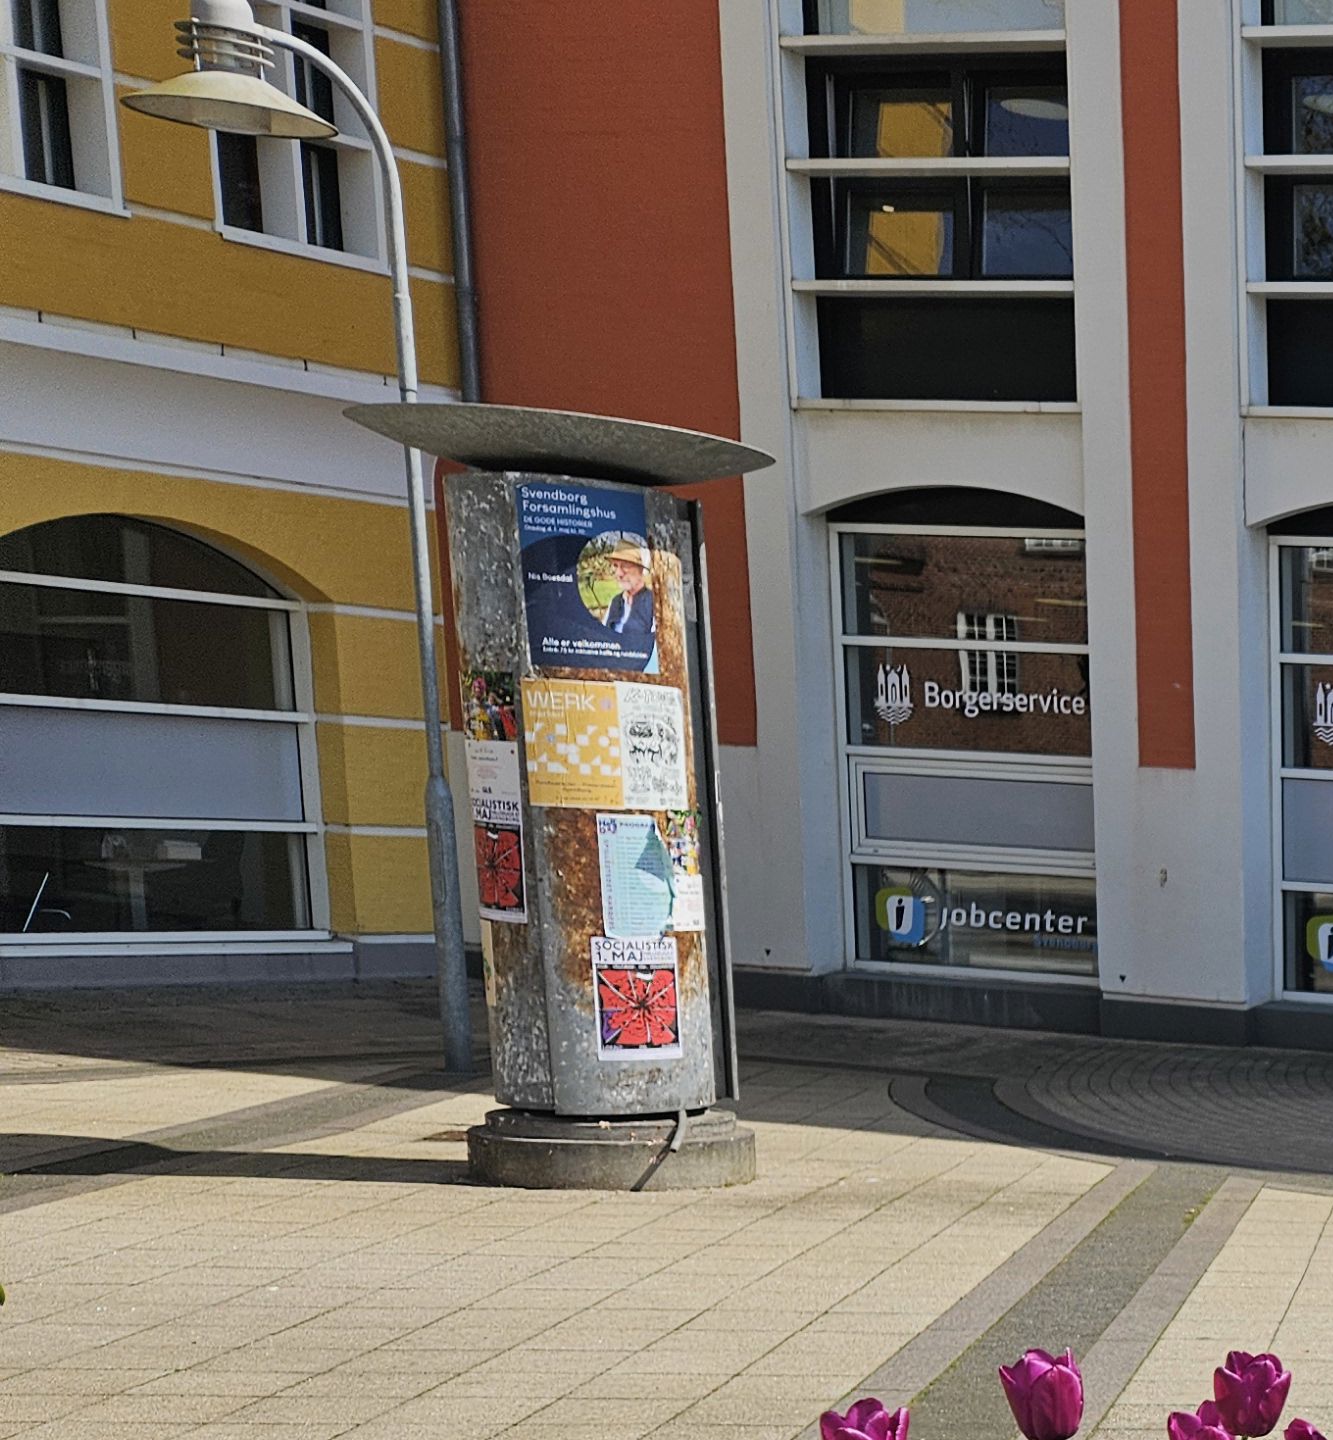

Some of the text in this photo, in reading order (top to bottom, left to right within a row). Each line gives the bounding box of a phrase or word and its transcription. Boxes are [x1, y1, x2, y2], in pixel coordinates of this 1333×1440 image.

[521, 487, 588, 505] Svendborg
[523, 500, 616, 519] Forsamlingshus
[542, 637, 559, 647] Alle
[572, 640, 621, 650] velkommen
[526, 689, 596, 712] WERK
[924, 681, 1086, 718] Borgerservice
[939, 902, 1089, 935] jobcenter
[594, 941, 673, 951] SOCIALISTISK
[597, 952, 607, 962] 1.
[613, 951, 643, 962] MAJ
